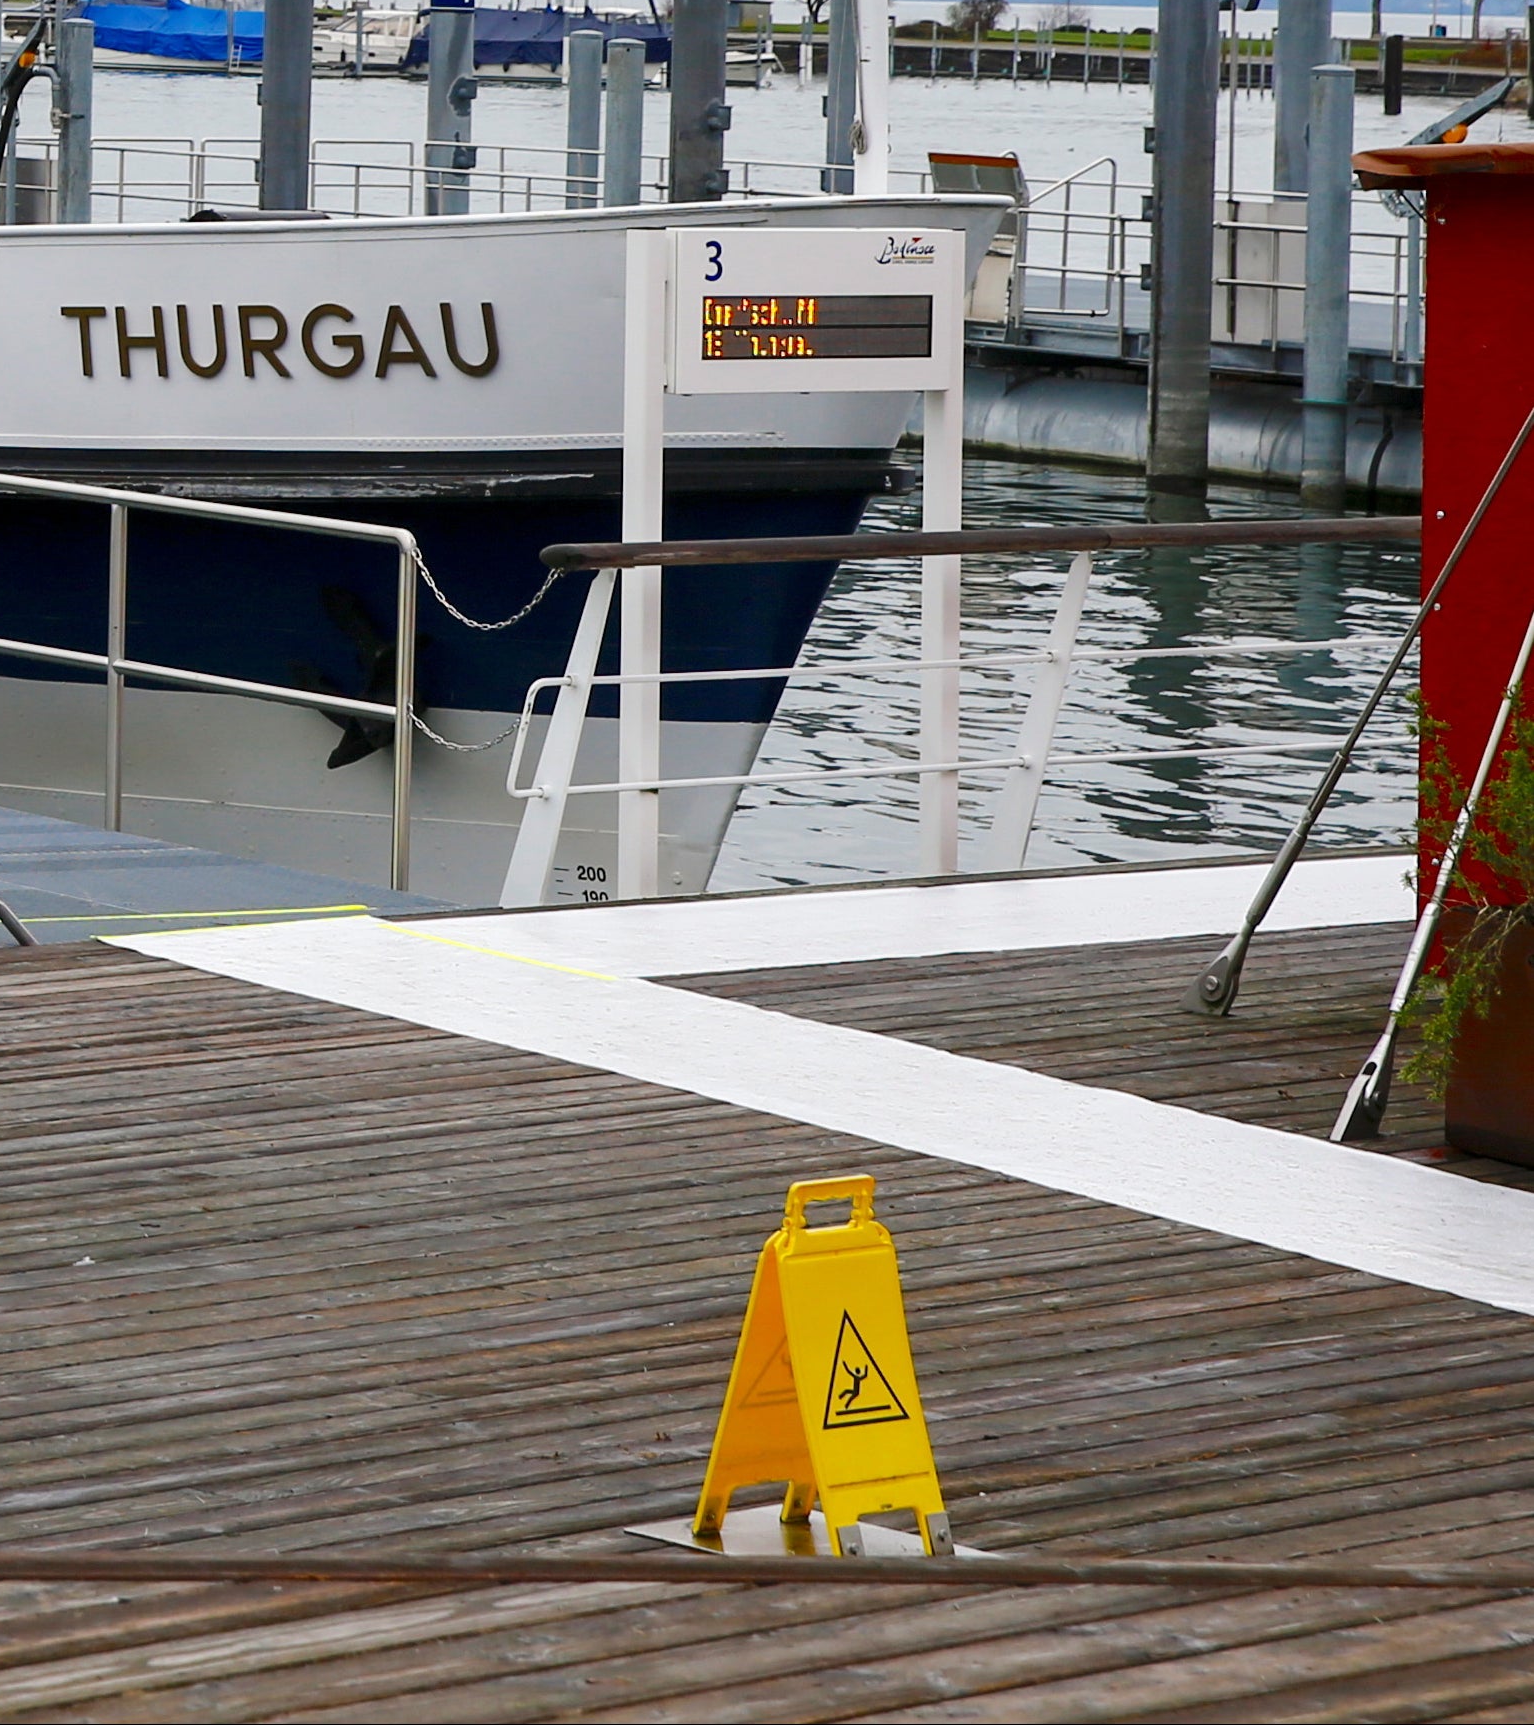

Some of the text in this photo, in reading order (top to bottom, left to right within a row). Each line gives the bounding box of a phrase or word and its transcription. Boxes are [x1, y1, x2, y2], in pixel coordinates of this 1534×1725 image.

[704, 240, 723, 282] 3
[61, 301, 501, 379] THURGAU
[576, 865, 607, 883] 200
